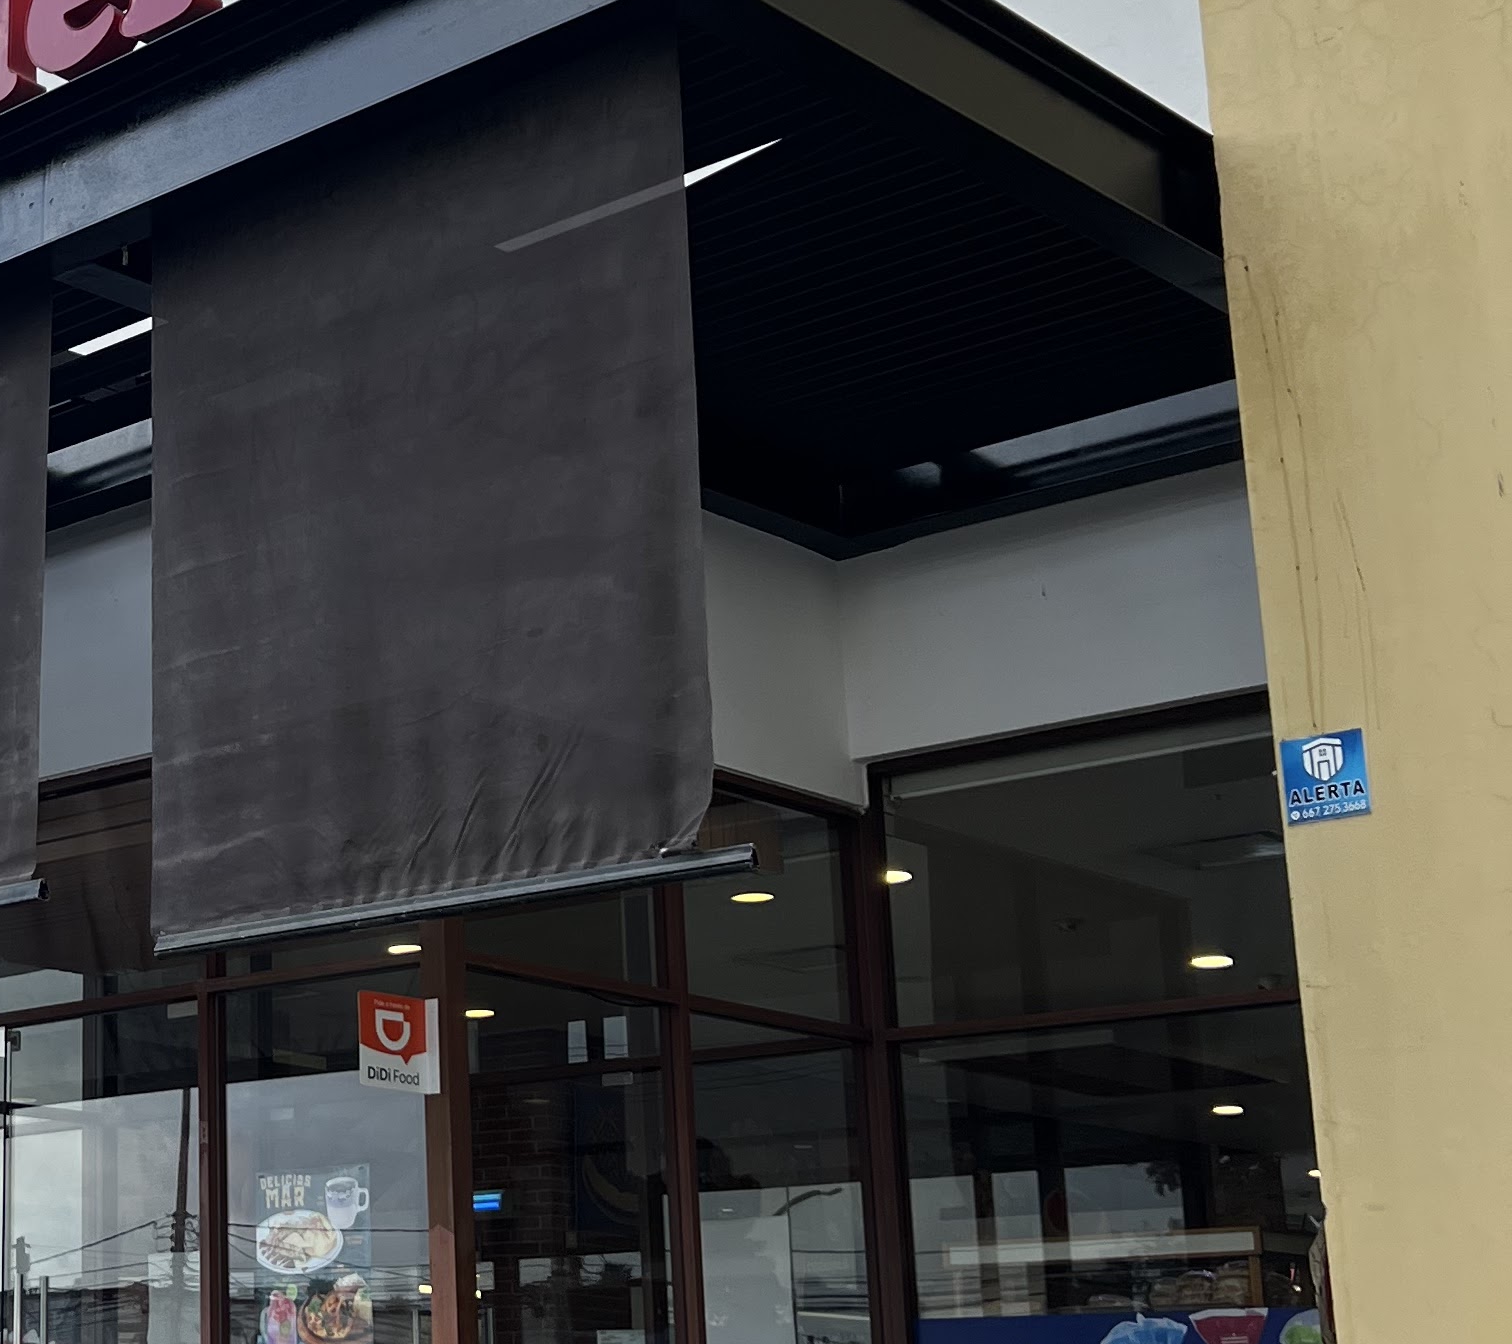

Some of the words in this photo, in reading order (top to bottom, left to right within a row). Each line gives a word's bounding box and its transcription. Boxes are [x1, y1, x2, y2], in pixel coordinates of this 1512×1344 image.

[1289, 778, 1365, 807] ALERTA
[1302, 806, 1320, 818] 667
[1323, 803, 1342, 816] 275
[1343, 799, 1367, 812] 3668
[367, 1065, 392, 1083] DiDi
[393, 1068, 420, 1086] Food
[265, 1186, 305, 1209] MAR
